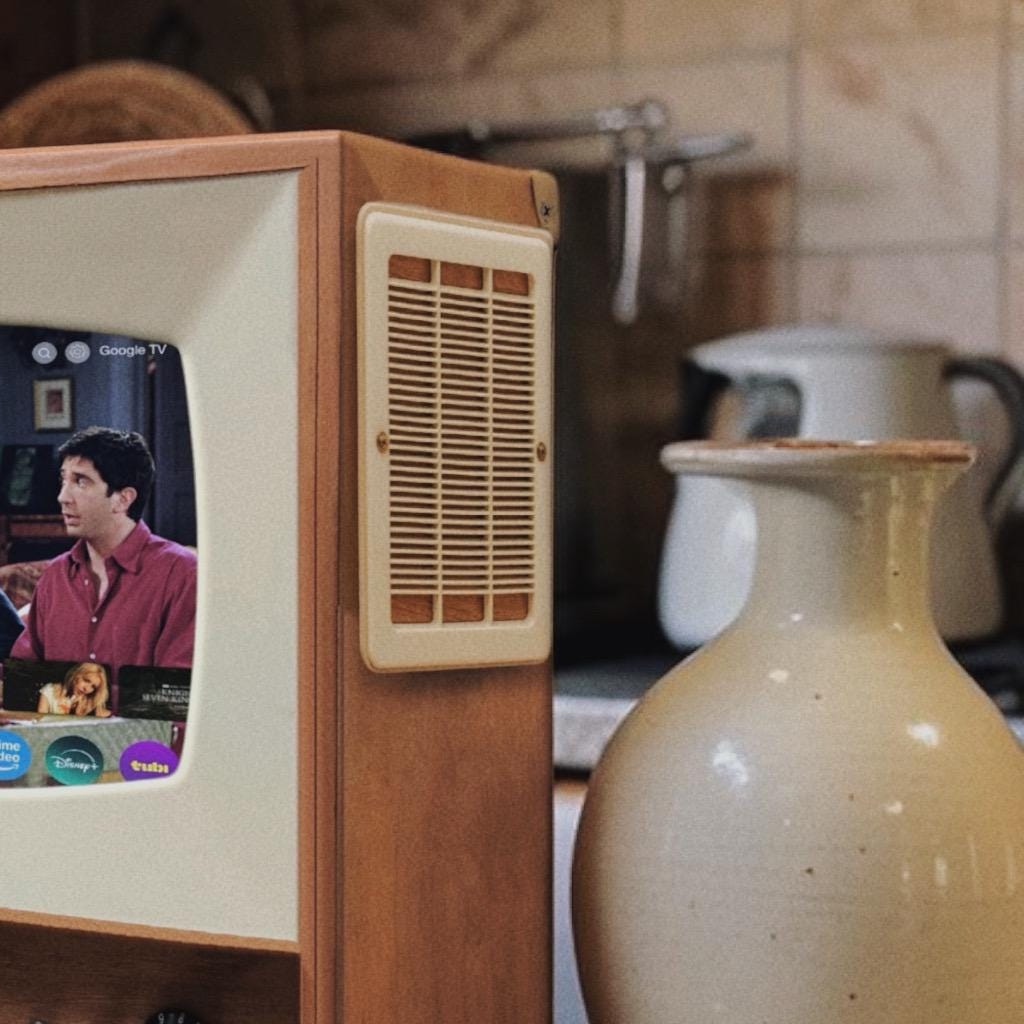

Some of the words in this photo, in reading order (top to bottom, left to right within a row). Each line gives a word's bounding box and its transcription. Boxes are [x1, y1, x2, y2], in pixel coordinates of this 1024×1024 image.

[98, 344, 146, 358] Google
[148, 343, 167, 355] TV
[130, 760, 169, 774] tubi
